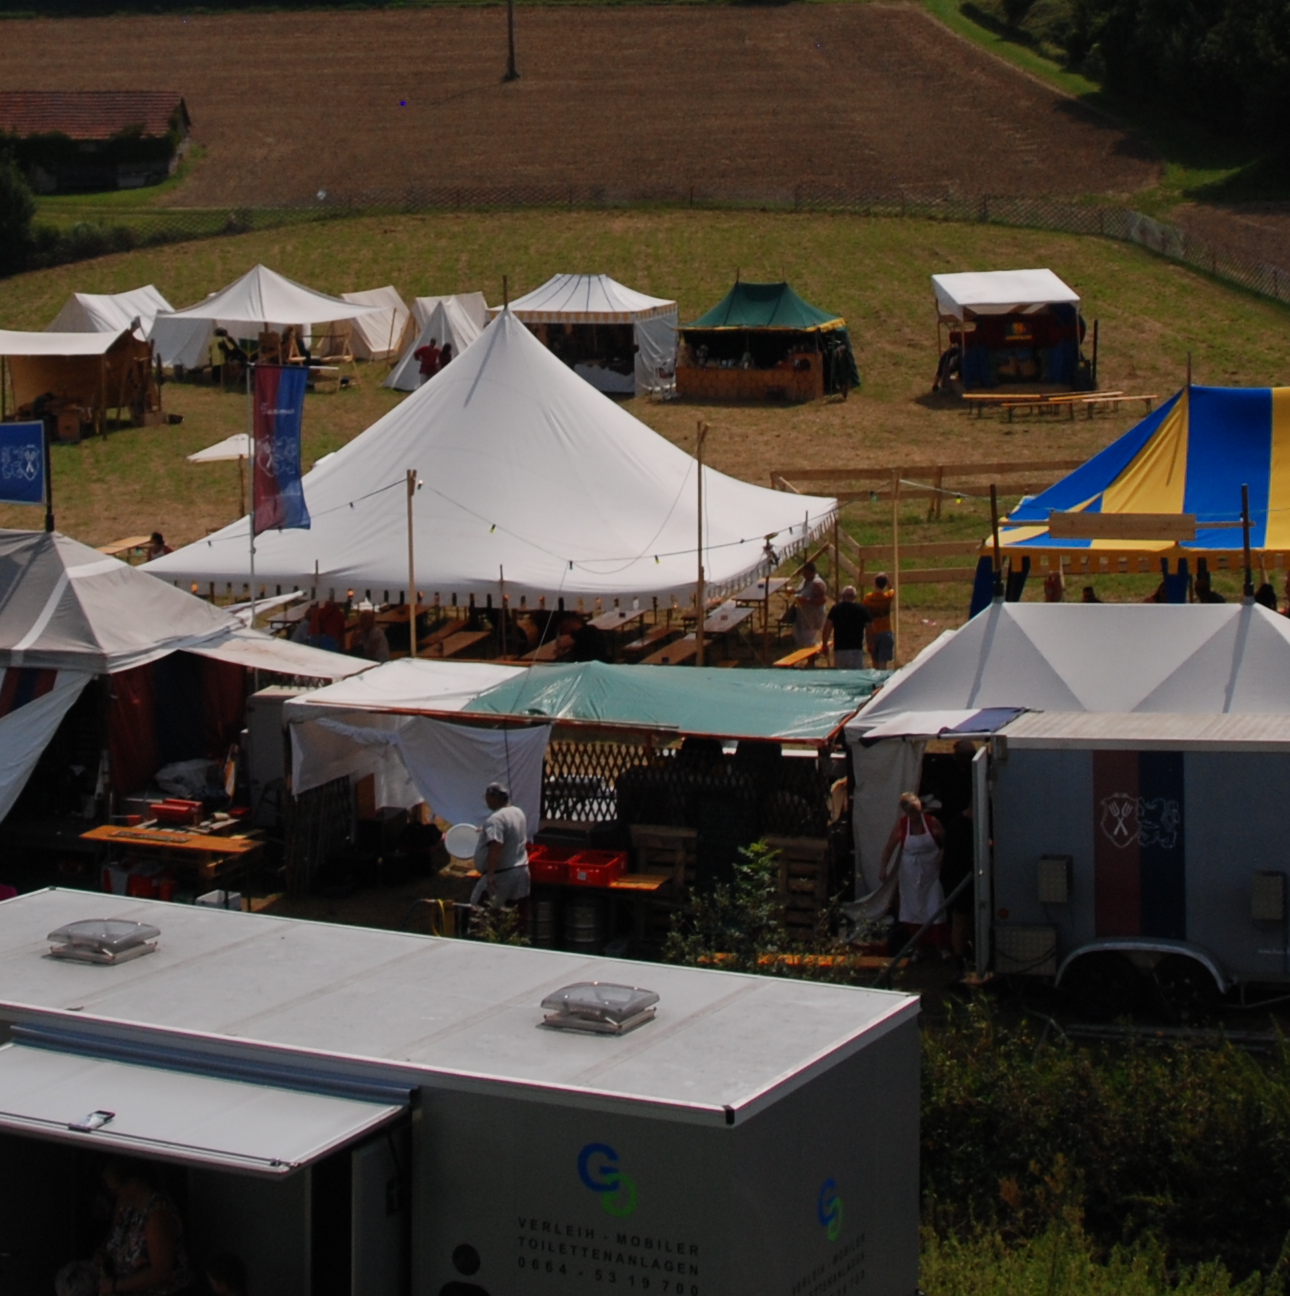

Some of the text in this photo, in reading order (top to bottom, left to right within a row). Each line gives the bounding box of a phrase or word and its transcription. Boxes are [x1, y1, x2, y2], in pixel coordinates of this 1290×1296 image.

[518, 1216, 595, 1239] VERLEIH
[616, 1233, 699, 1256] MOBILER
[518, 1236, 699, 1276] TOILETTENANLAGEN
[517, 1256, 567, 1275] 0664
[595, 1269, 617, 1283] 53
[628, 1275, 651, 1289] 19
[662, 1280, 699, 1296] 700
